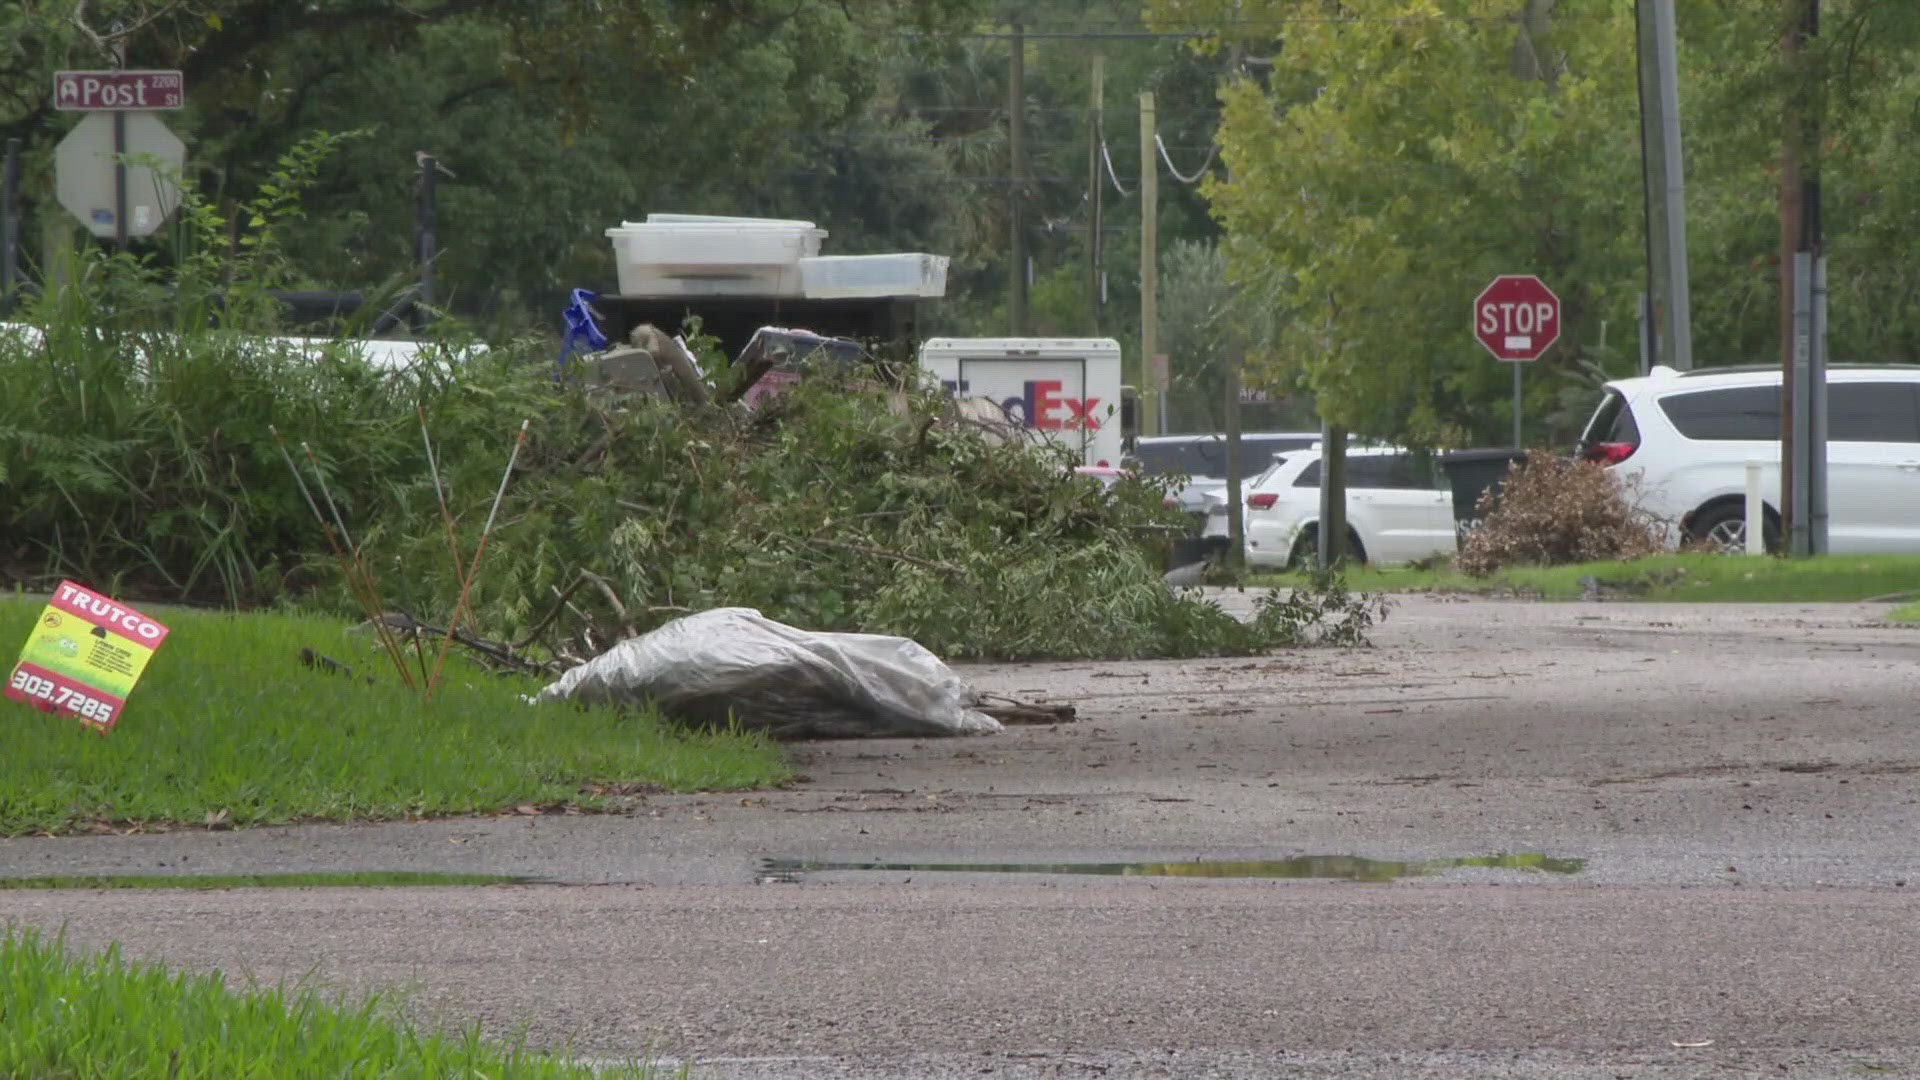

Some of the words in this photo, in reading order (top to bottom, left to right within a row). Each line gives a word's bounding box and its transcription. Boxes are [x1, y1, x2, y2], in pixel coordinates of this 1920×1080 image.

[83, 78, 147, 105] Post
[165, 93, 178, 105] St
[1481, 303, 1553, 334] STOP
[62, 586, 160, 639] TRUTCO
[11, 670, 113, 723] 303.7285
